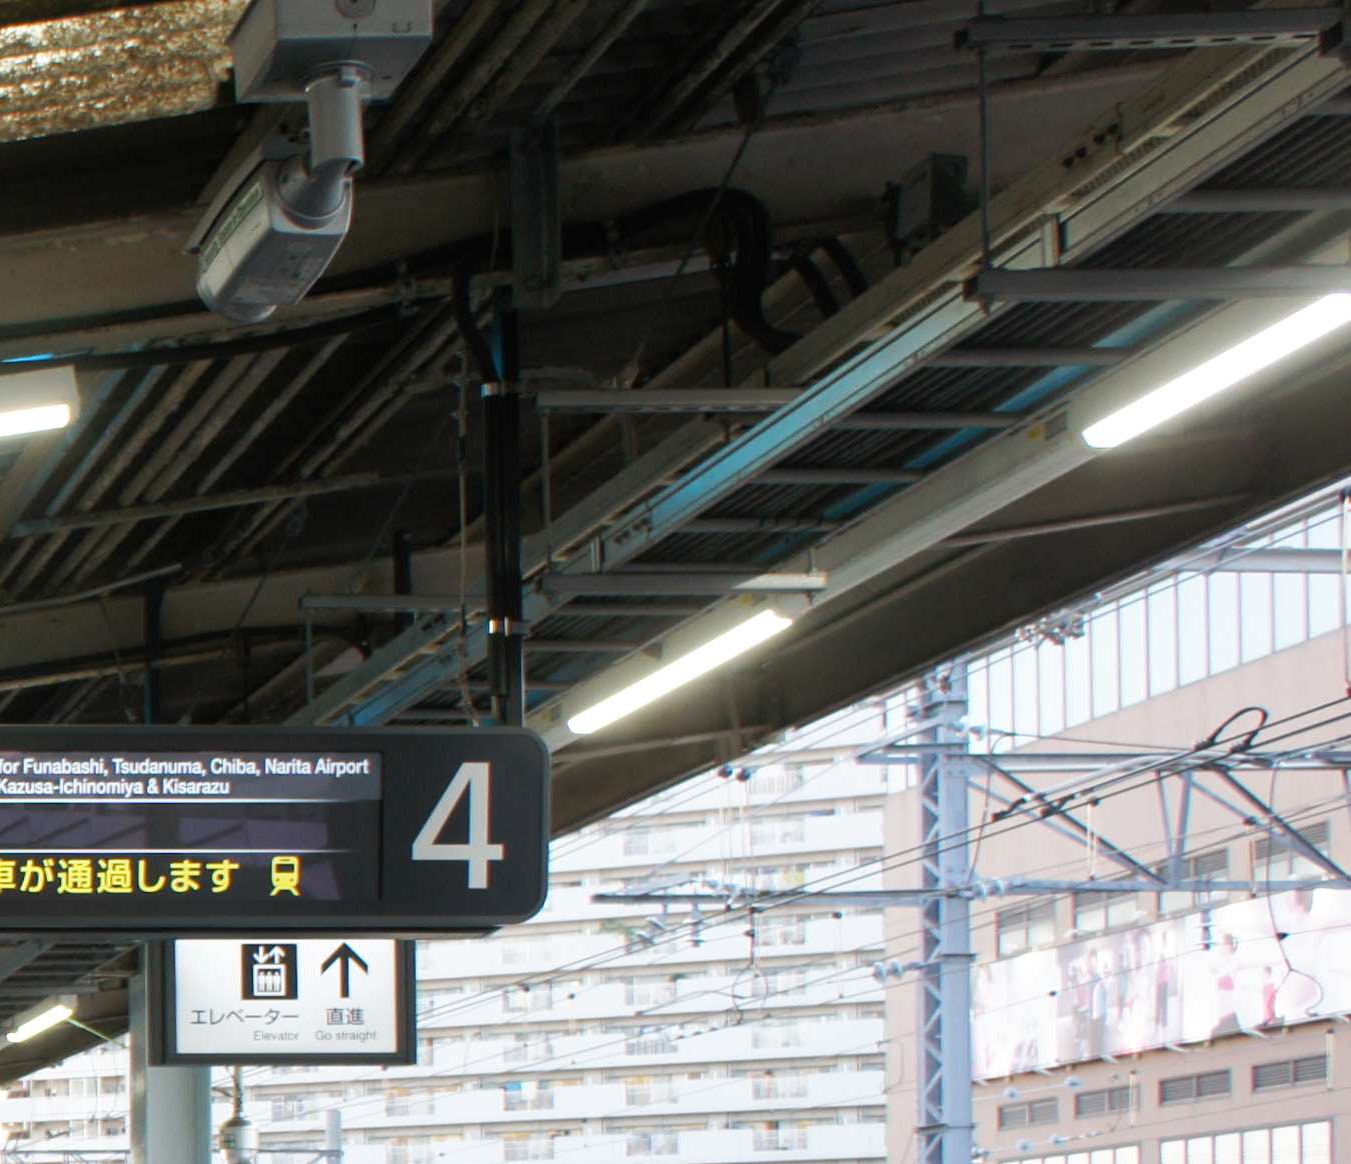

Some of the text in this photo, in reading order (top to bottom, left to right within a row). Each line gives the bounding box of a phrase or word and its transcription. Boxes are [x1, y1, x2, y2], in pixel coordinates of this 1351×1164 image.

[23, 757, 109, 777] Funabashi,
[111, 757, 207, 777] Tsudanuma,
[210, 757, 261, 777] Chiba,
[264, 758, 312, 775] Narita
[314, 758, 369, 777] Airport
[146, 777, 160, 795] &
[162, 777, 230, 795] Kisarazu
[411, 761, 504, 889] 4
[190, 1008, 299, 1026] エレベーター
[326, 1007, 365, 1026] 直進
[253, 1030, 300, 1042] Elevator
[315, 1030, 377, 1044] Go straight
